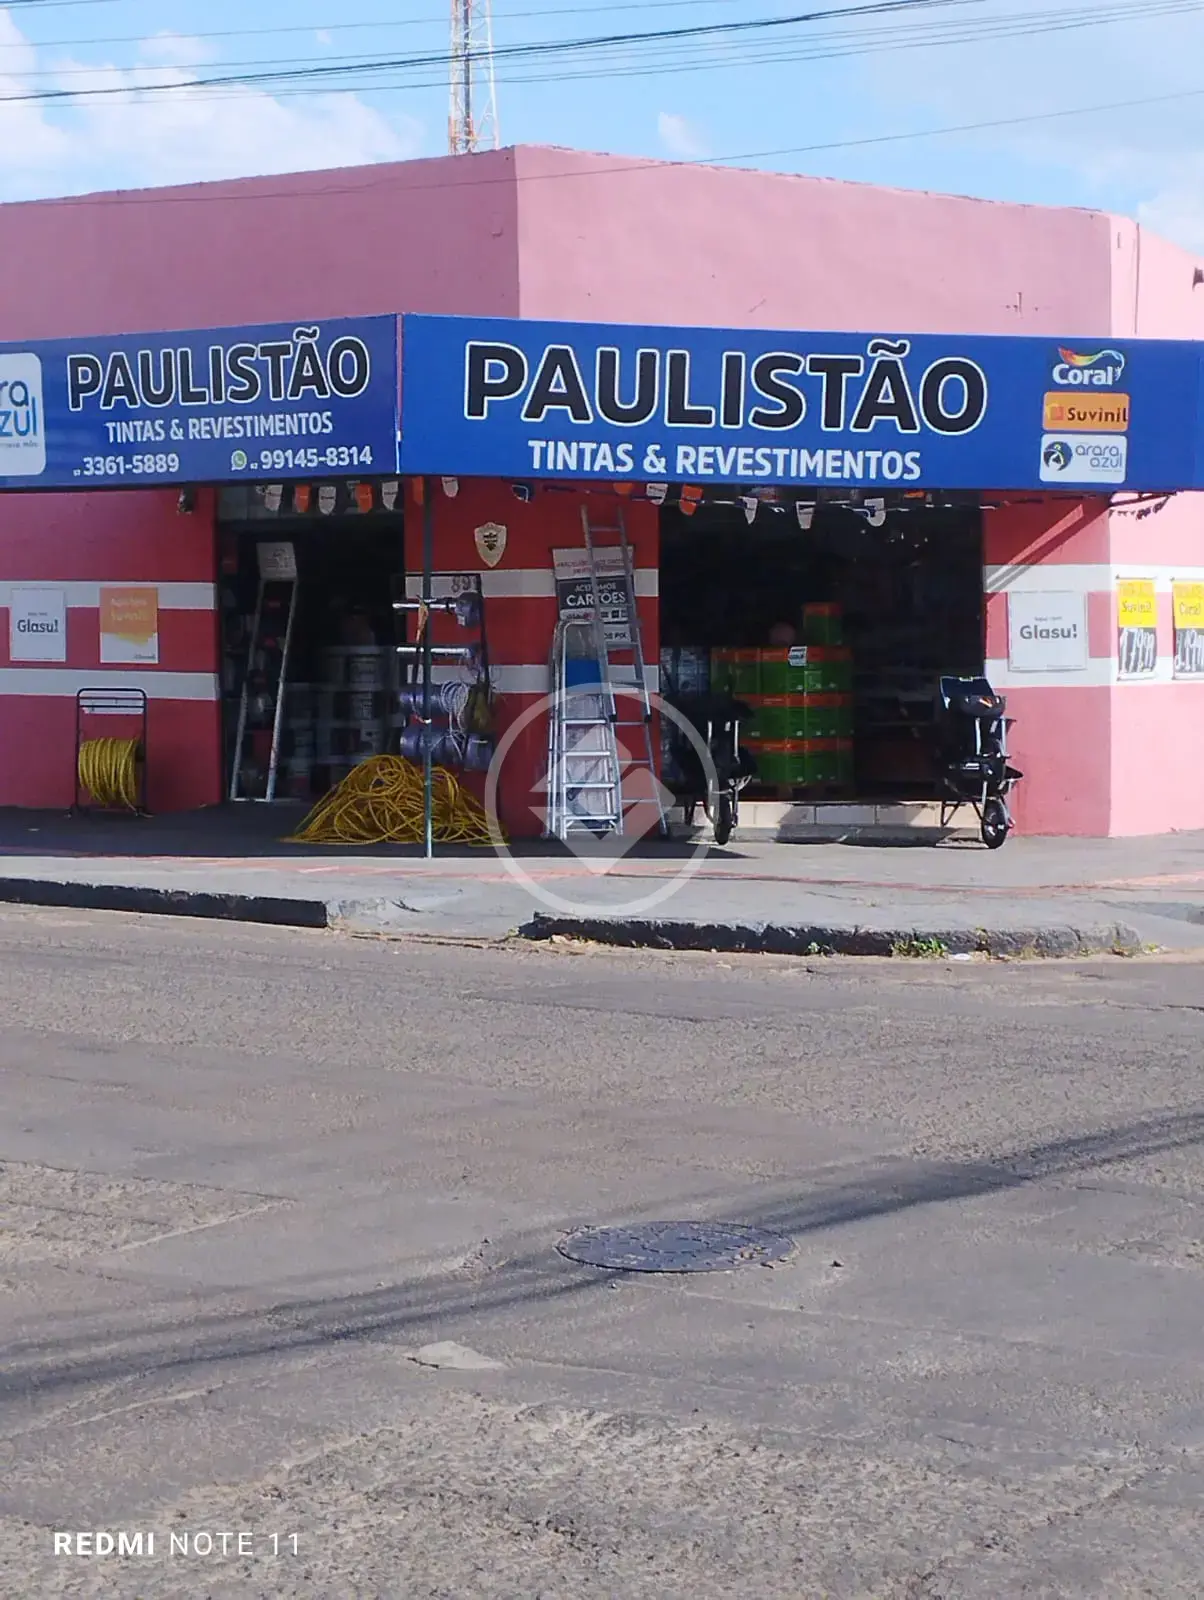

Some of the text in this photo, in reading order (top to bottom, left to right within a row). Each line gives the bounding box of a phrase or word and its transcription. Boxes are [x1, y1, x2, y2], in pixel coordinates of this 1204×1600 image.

[67, 326, 370, 411] PAULISTÃO
[1052, 363, 1113, 385] Coral
[465, 339, 988, 435] PAULISTÃO
[0, 396, 37, 437] zul
[1067, 407, 1128, 423] Suvinil
[107, 412, 332, 443] TINTAS & REVESTIMENTOS
[260, 446, 372, 470] 99145-8314
[528, 440, 921, 481] TINTAS & REVESTIMENTOS
[1075, 443, 1120, 456] arara
[1090, 453, 1123, 468] azul
[84, 454, 179, 475] 3361-5889
[17, 619, 59, 633] Glasu!
[1020, 624, 1078, 639] Glasu!
